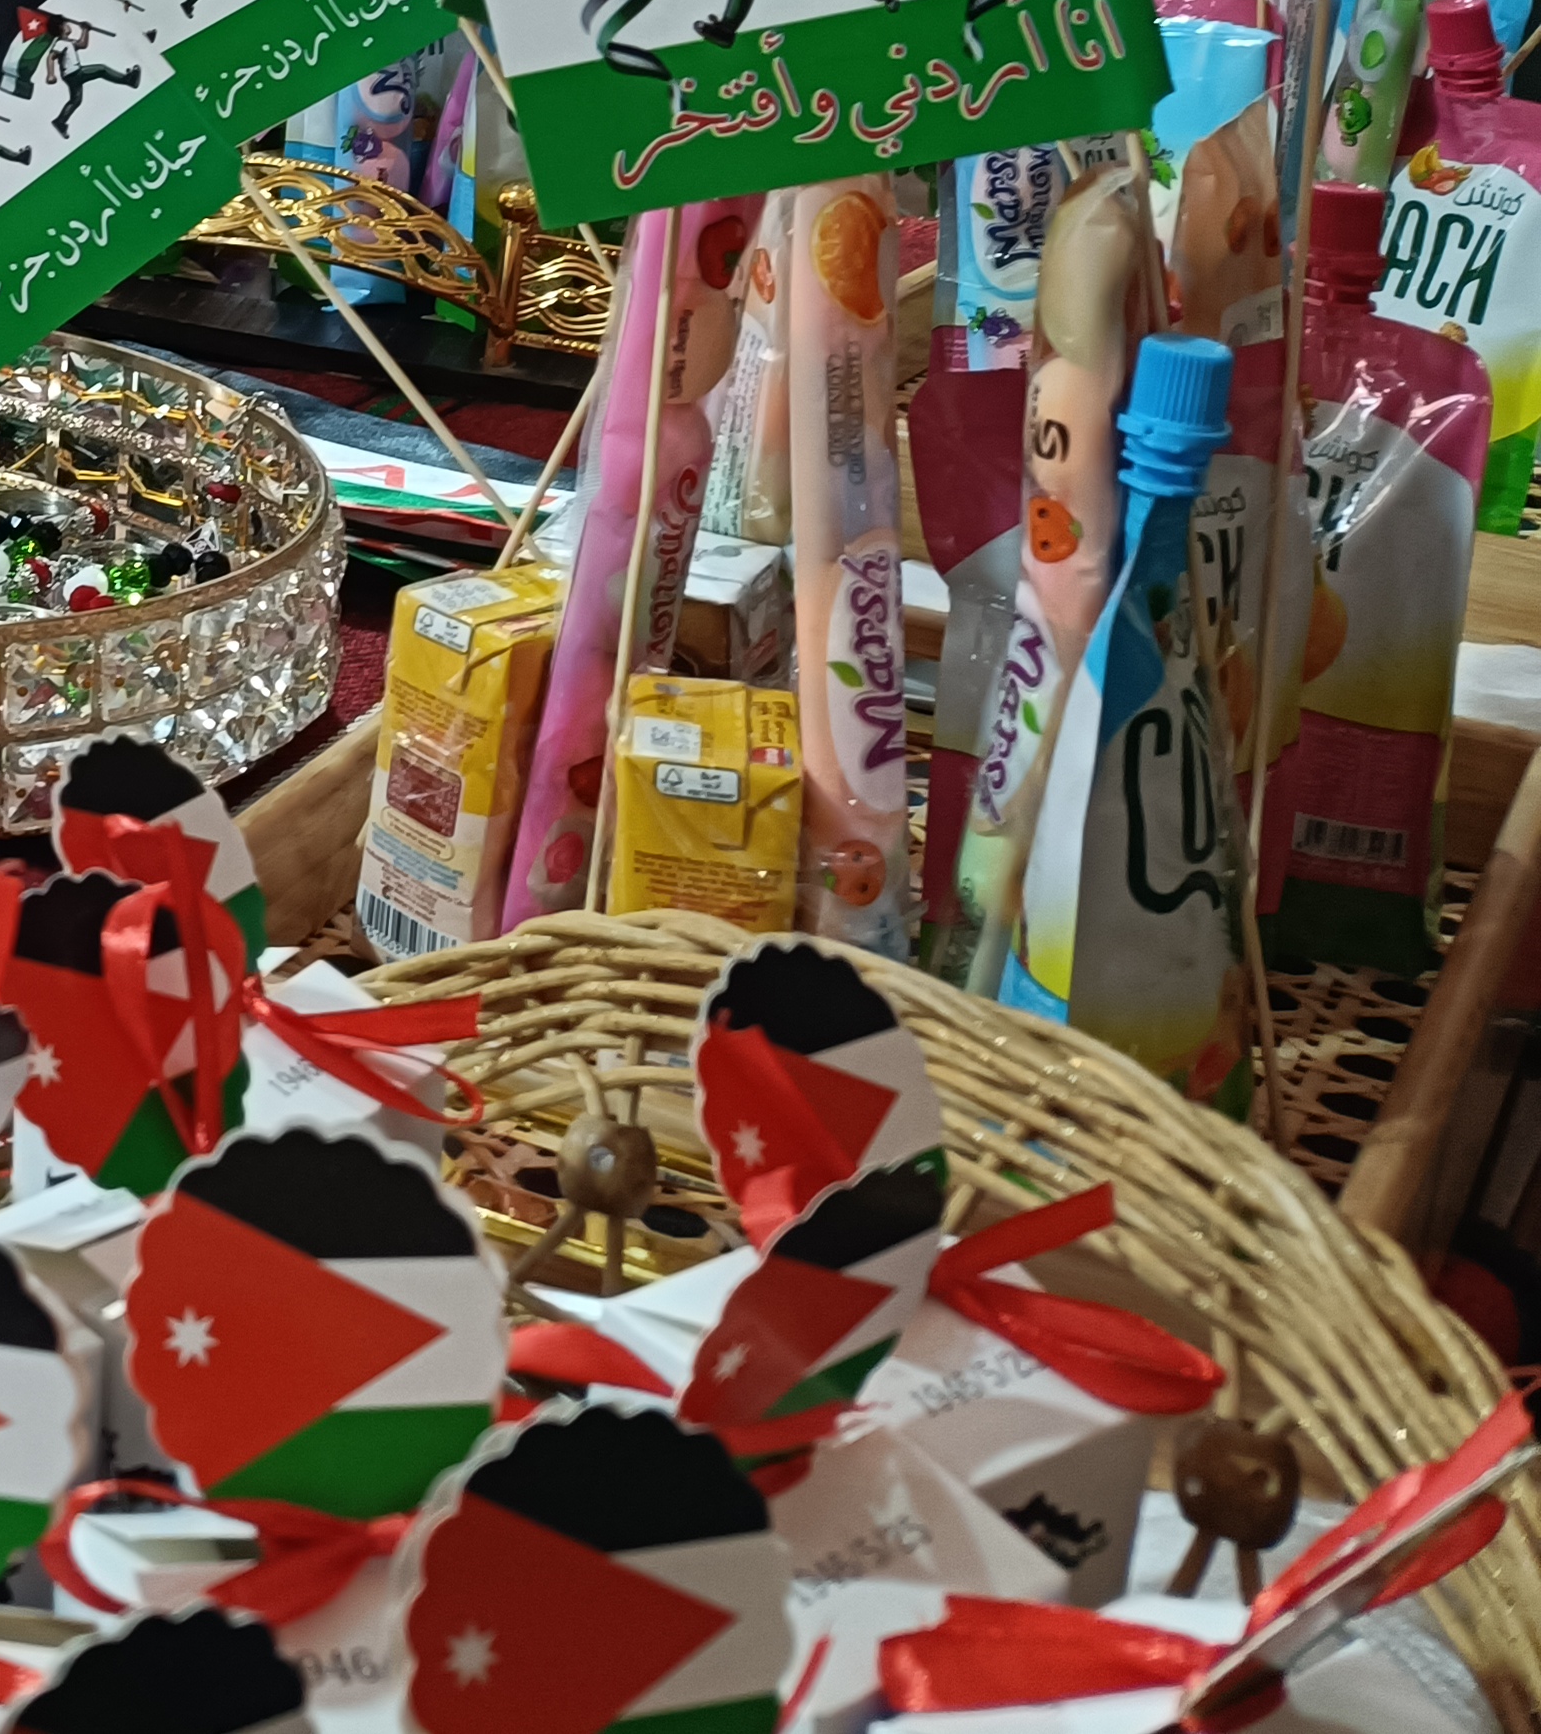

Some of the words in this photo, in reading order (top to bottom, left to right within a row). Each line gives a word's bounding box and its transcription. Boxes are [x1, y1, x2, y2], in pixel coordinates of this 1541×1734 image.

[612, 29, 841, 189] وأفتخر
[53, 163, 122, 266] أردن
[1378, 196, 1508, 327] ACH
